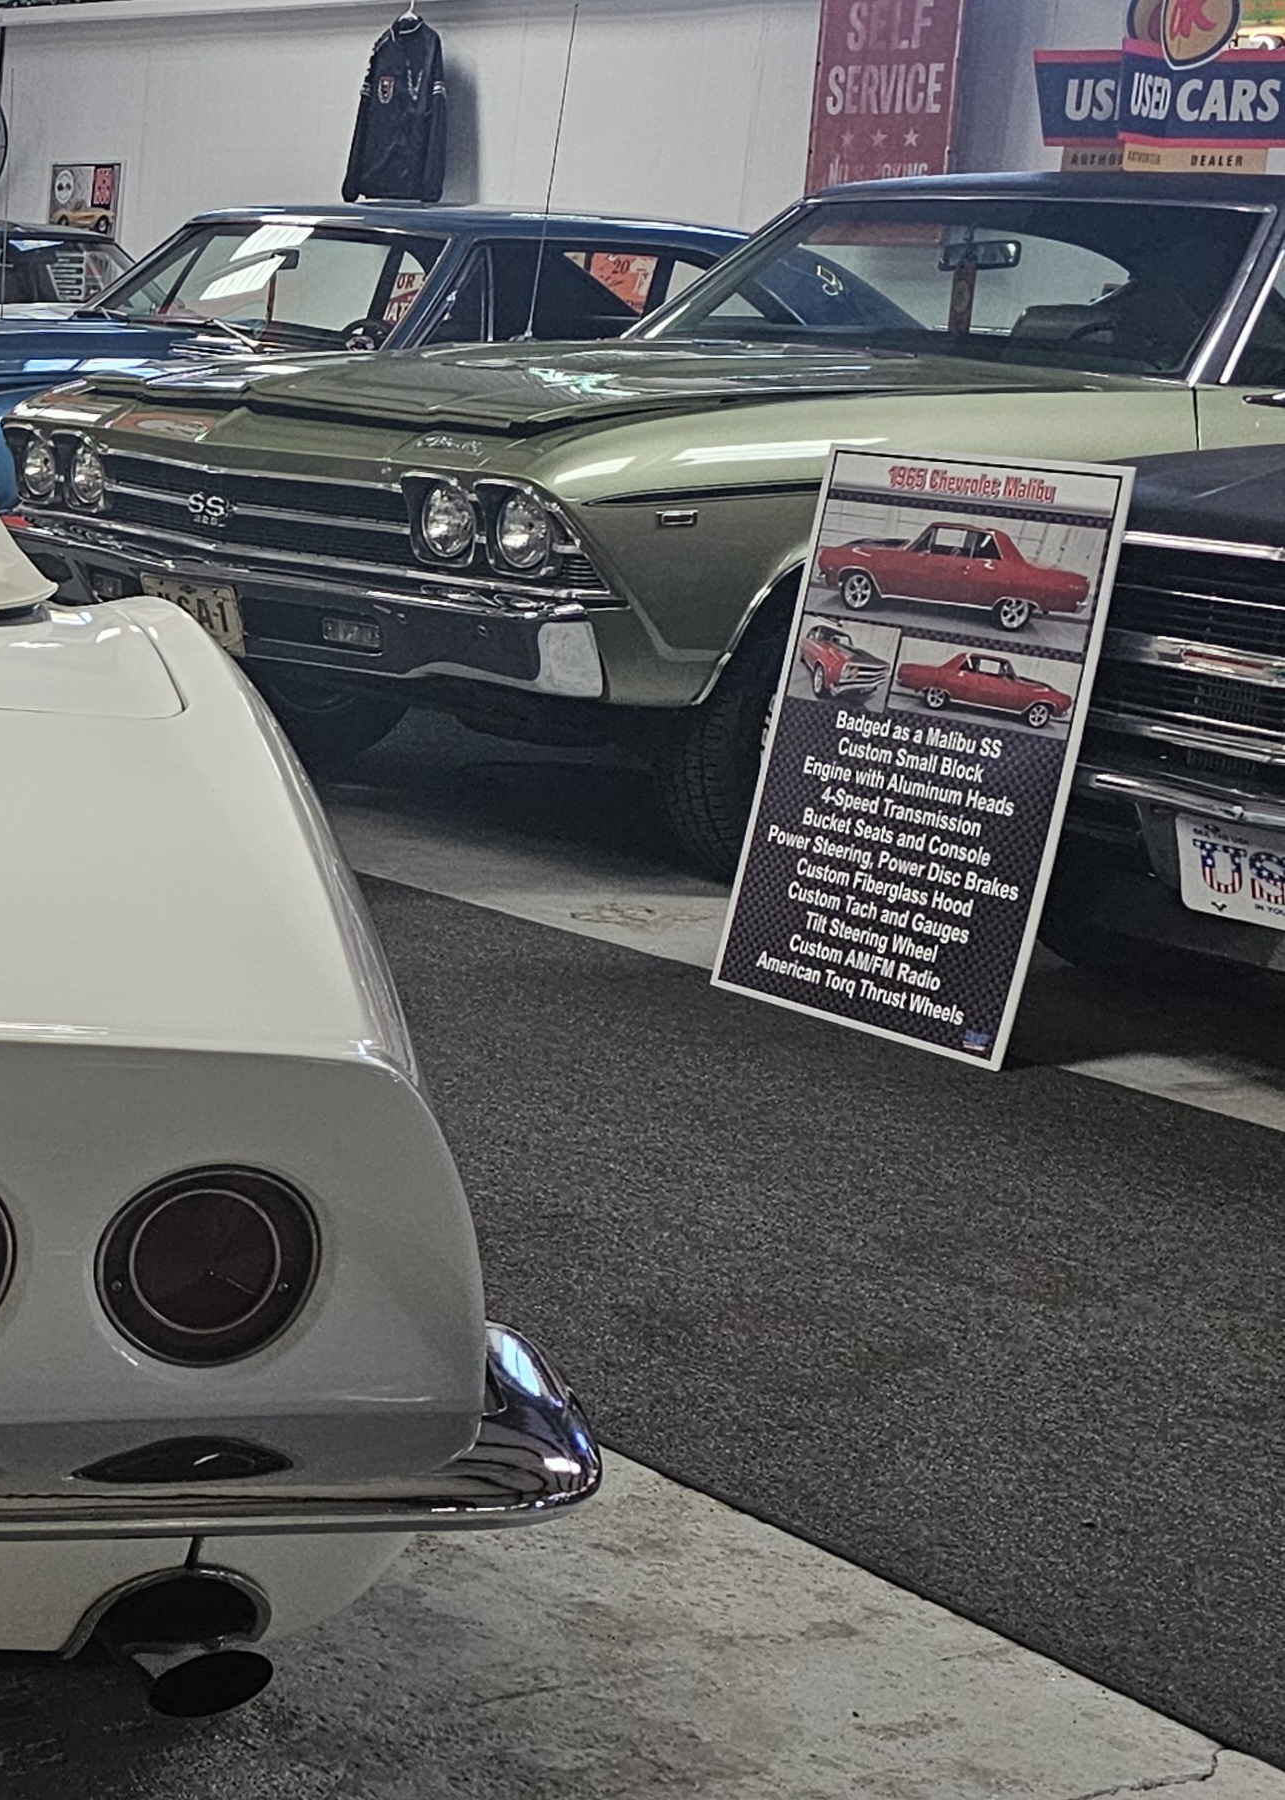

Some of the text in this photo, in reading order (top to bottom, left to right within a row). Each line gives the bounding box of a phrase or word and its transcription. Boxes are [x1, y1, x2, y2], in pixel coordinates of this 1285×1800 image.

[847, 0, 933, 51] SELF
[826, 62, 946, 117] SERVICE
[1064, 78, 1121, 121] US
[1130, 72, 1281, 122] USED CARS
[1191, 154, 1243, 167] DEALER
[187, 492, 226, 517] SS
[888, 465, 1057, 503] 1965 Chevrolet Malibu
[836, 710, 1003, 759] Badged as a Malibu SS
[838, 737, 985, 784] Custom Small Block
[803, 755, 1015, 817] Engine with Aluminum Heads
[821, 785, 982, 838] 4-Speed Transmission
[767, 824, 1019, 901] Power Steering, Power Disc Brakes
[802, 806, 991, 867] Bucket Seats and Console
[787, 881, 970, 945] Custom Tach and Gauges
[796, 857, 975, 918] Custom Fiberglass Hood
[789, 933, 941, 991] Custom AM/FM Radio
[806, 910, 939, 963] Tilt Steering Wheel
[756, 950, 965, 1026] American Torq Thrust Wheels
